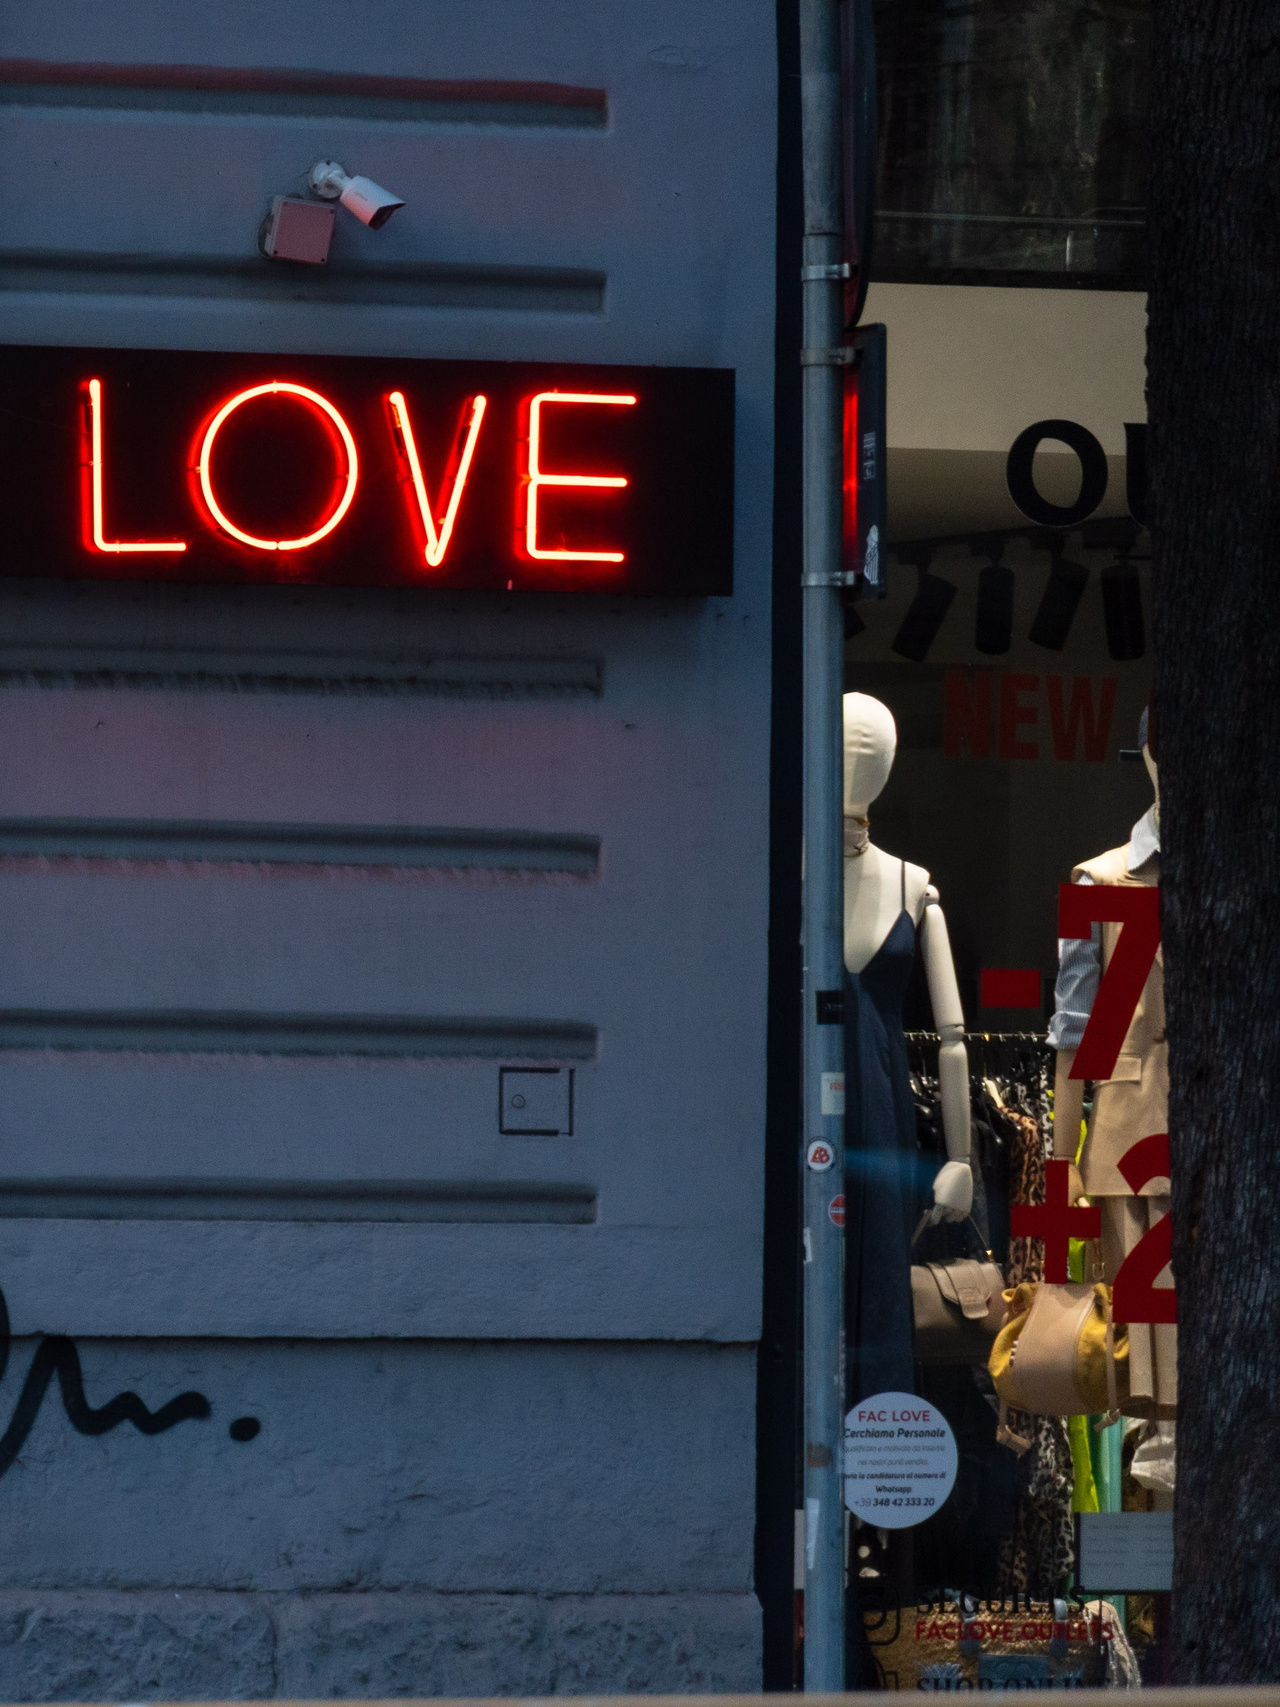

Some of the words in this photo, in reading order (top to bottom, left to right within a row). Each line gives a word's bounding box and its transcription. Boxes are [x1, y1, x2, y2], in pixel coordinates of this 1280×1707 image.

[84, 377, 638, 568] LOVE
[943, 669, 1119, 762] NEW
[858, 1410, 887, 1422] FAC
[892, 1410, 931, 1422] LOVE
[897, 1428, 946, 1438] Personale
[872, 1498, 890, 1507] 348
[892, 1498, 903, 1507] 42
[904, 1498, 921, 1507] 333
[923, 1498, 935, 1506] 20
